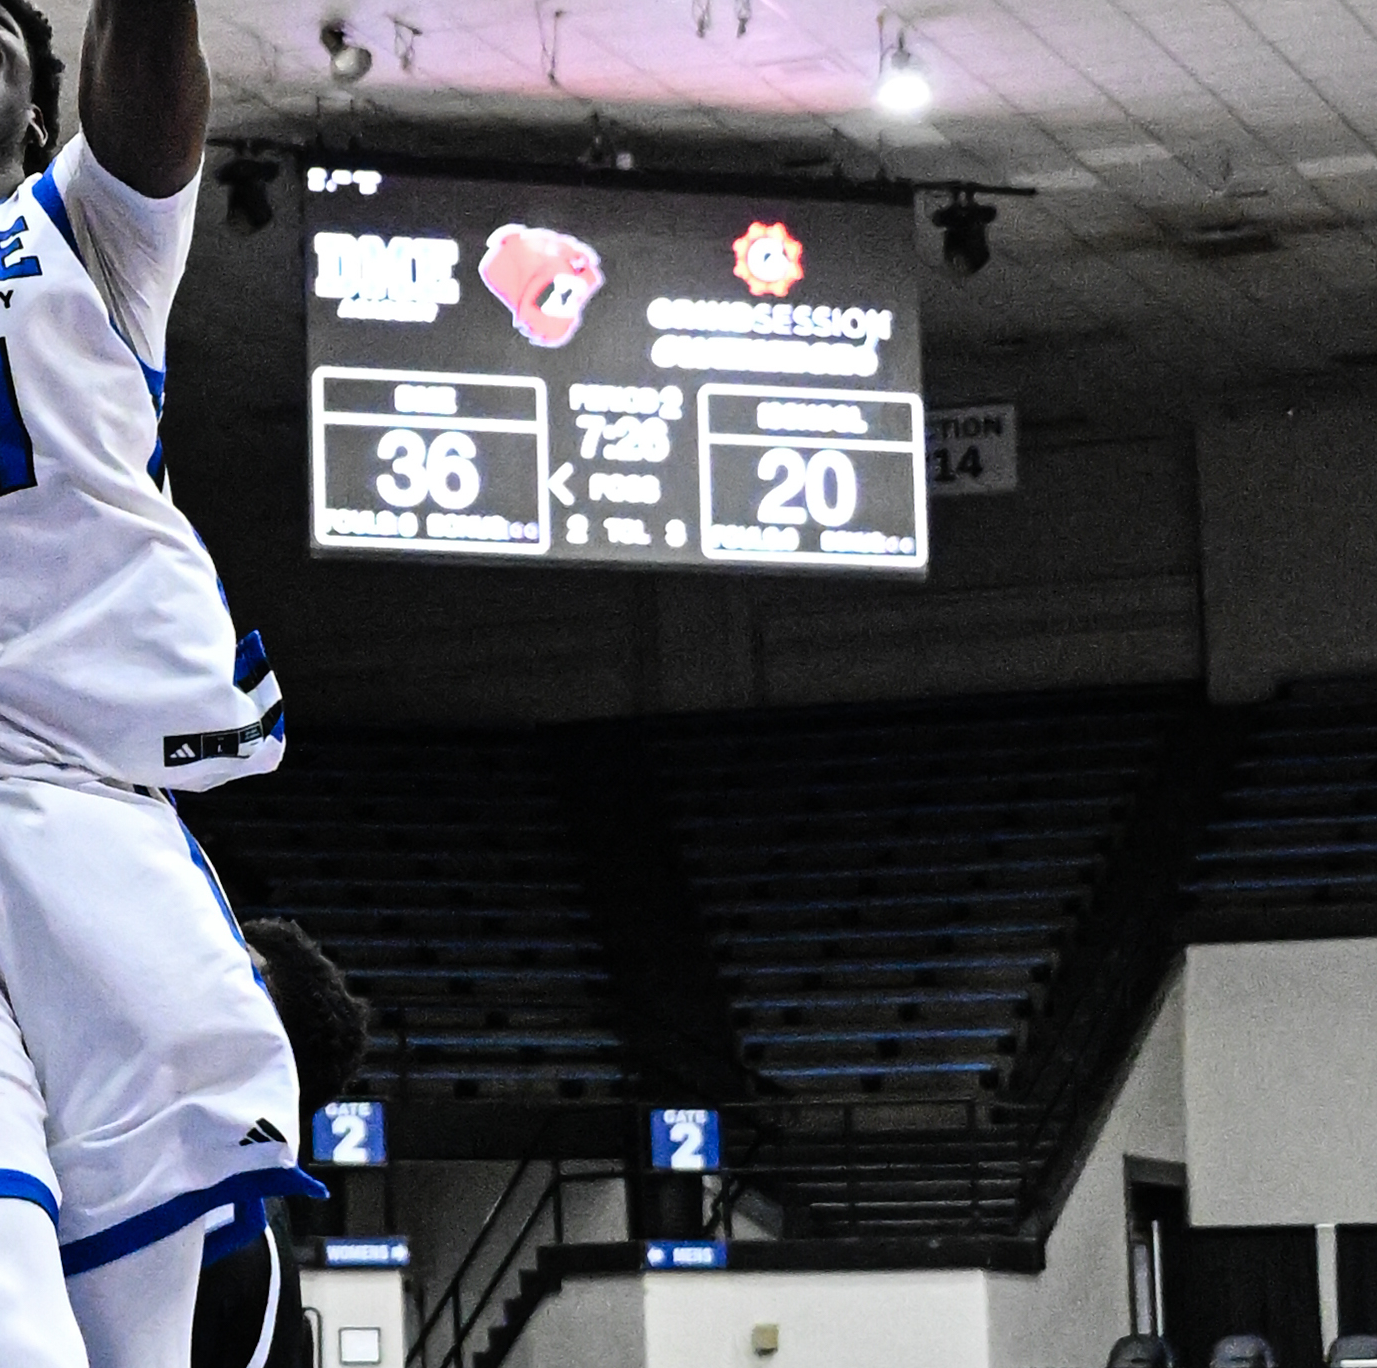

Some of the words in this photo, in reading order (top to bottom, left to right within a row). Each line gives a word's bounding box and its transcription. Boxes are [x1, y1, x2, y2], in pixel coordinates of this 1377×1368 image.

[934, 416, 1002, 438] TION
[375, 428, 481, 510] 36
[925, 445, 983, 482] 14
[756, 447, 858, 528] 20
[325, 1102, 372, 1119] GATE
[663, 1109, 708, 1124] GATE
[331, 1116, 369, 1163] 2
[669, 1122, 705, 1170] 2
